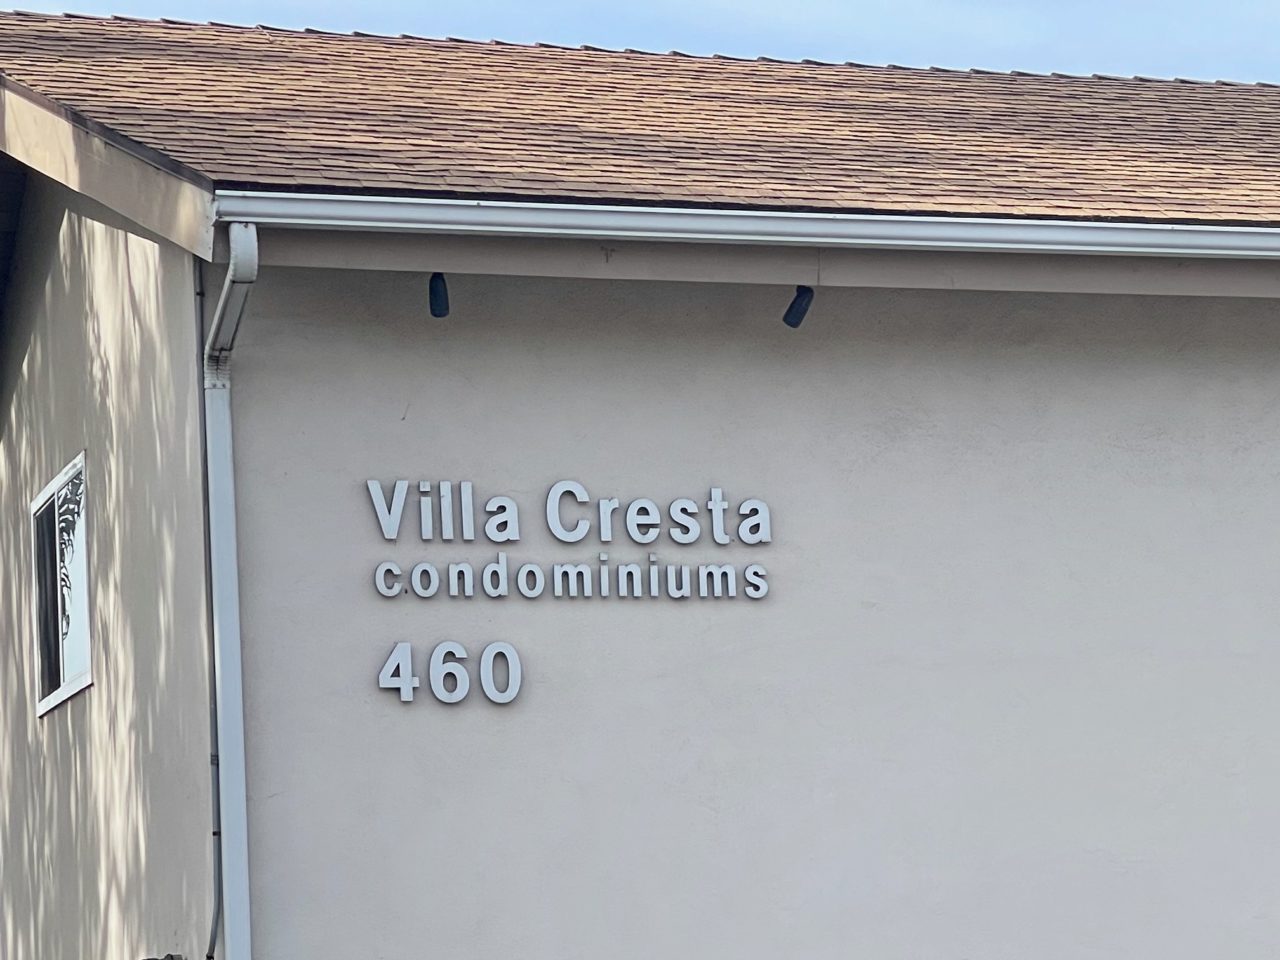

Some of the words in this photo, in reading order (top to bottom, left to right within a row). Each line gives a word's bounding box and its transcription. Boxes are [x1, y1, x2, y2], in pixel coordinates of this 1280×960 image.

[367, 480, 520, 542] Villa
[546, 480, 772, 545] Cresta
[375, 552, 769, 598] condominiums
[378, 641, 523, 704] 460
